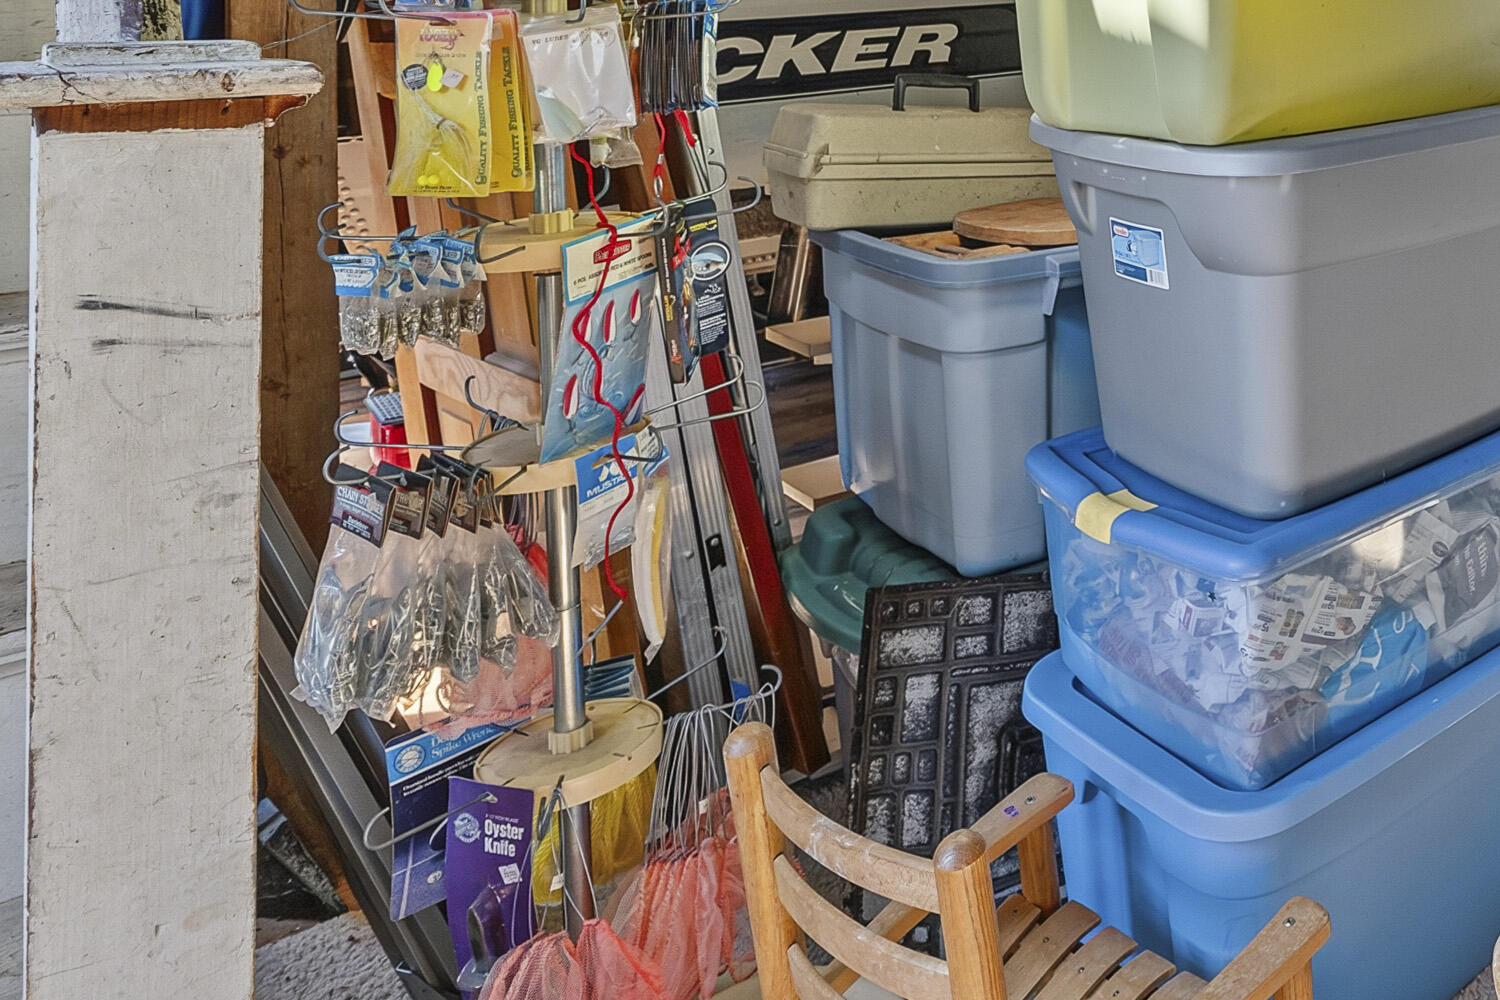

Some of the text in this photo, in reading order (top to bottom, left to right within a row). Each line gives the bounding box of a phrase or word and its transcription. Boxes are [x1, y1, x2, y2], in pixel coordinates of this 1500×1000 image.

[337, 486, 358, 503] CHAIN
[586, 472, 631, 498] MUSTA
[431, 741, 461, 759] Spike
[484, 819, 525, 841] Oyster
[484, 837, 516, 857] Knife
